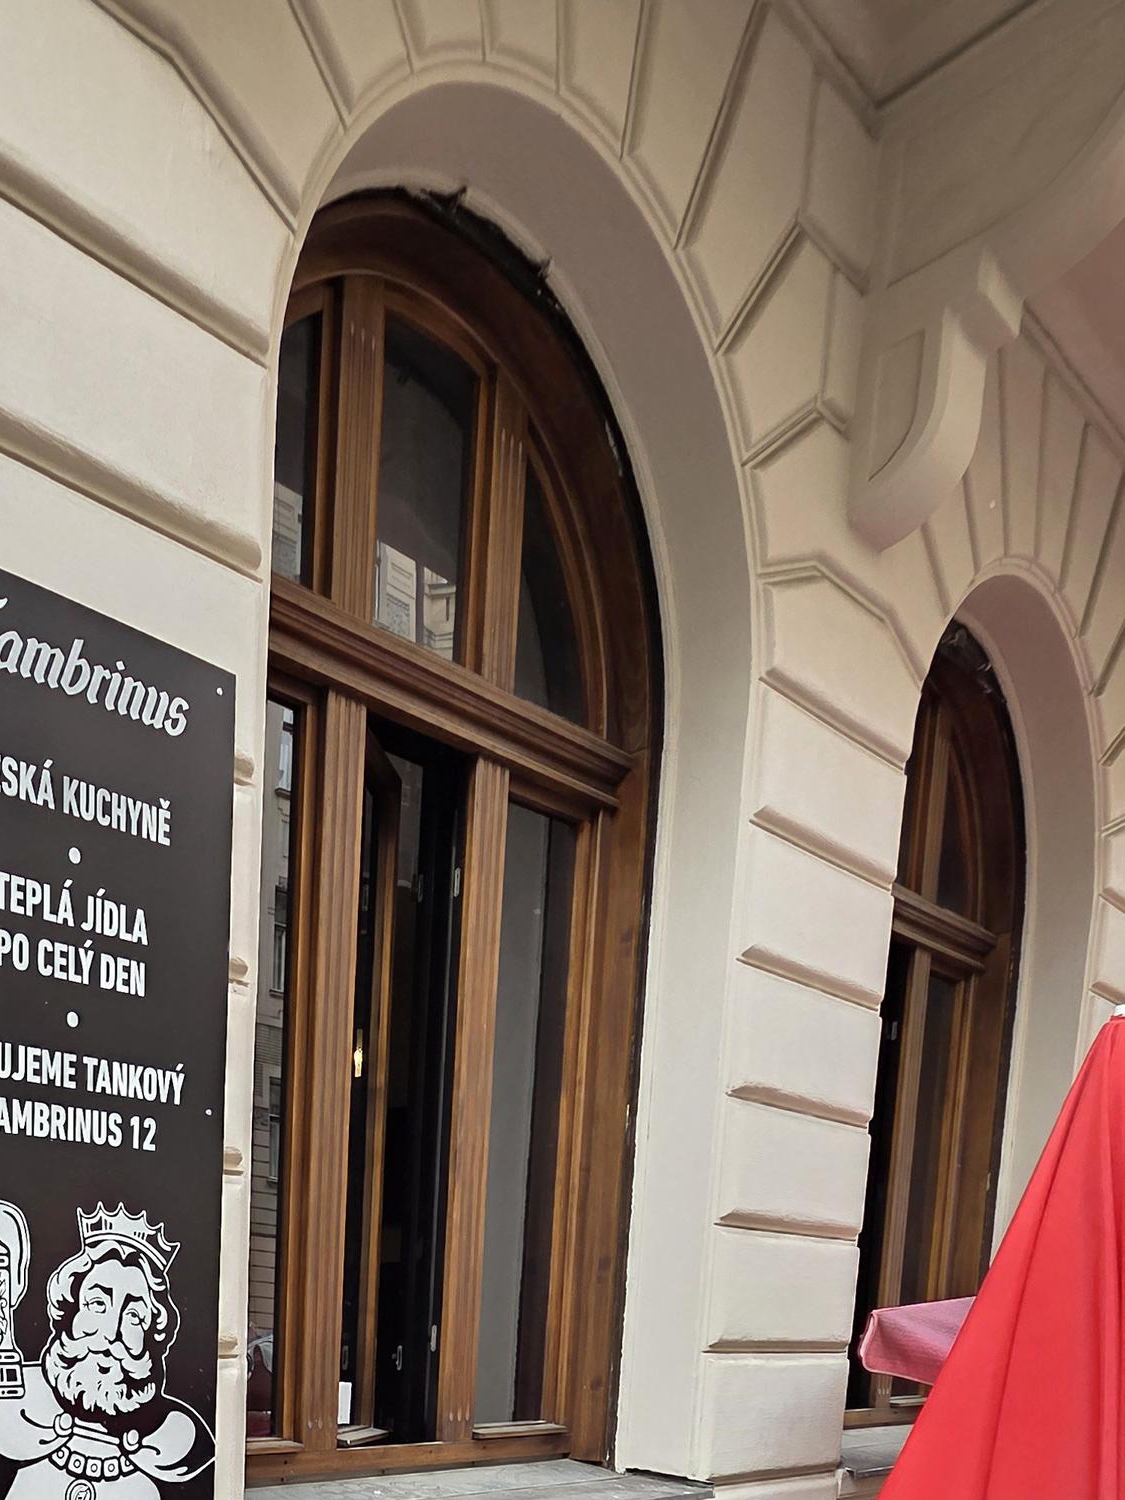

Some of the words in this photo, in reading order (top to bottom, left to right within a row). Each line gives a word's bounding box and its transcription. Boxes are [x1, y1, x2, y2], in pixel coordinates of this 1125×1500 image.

[62, 775, 171, 847] KUCHYNĚ
[80, 887, 149, 946] JÍDLA
[37, 938, 95, 985] CELÝ
[99, 952, 146, 998] DEN
[82, 1055, 185, 1106] TANKOVÝ
[129, 1115, 157, 1152] 12
